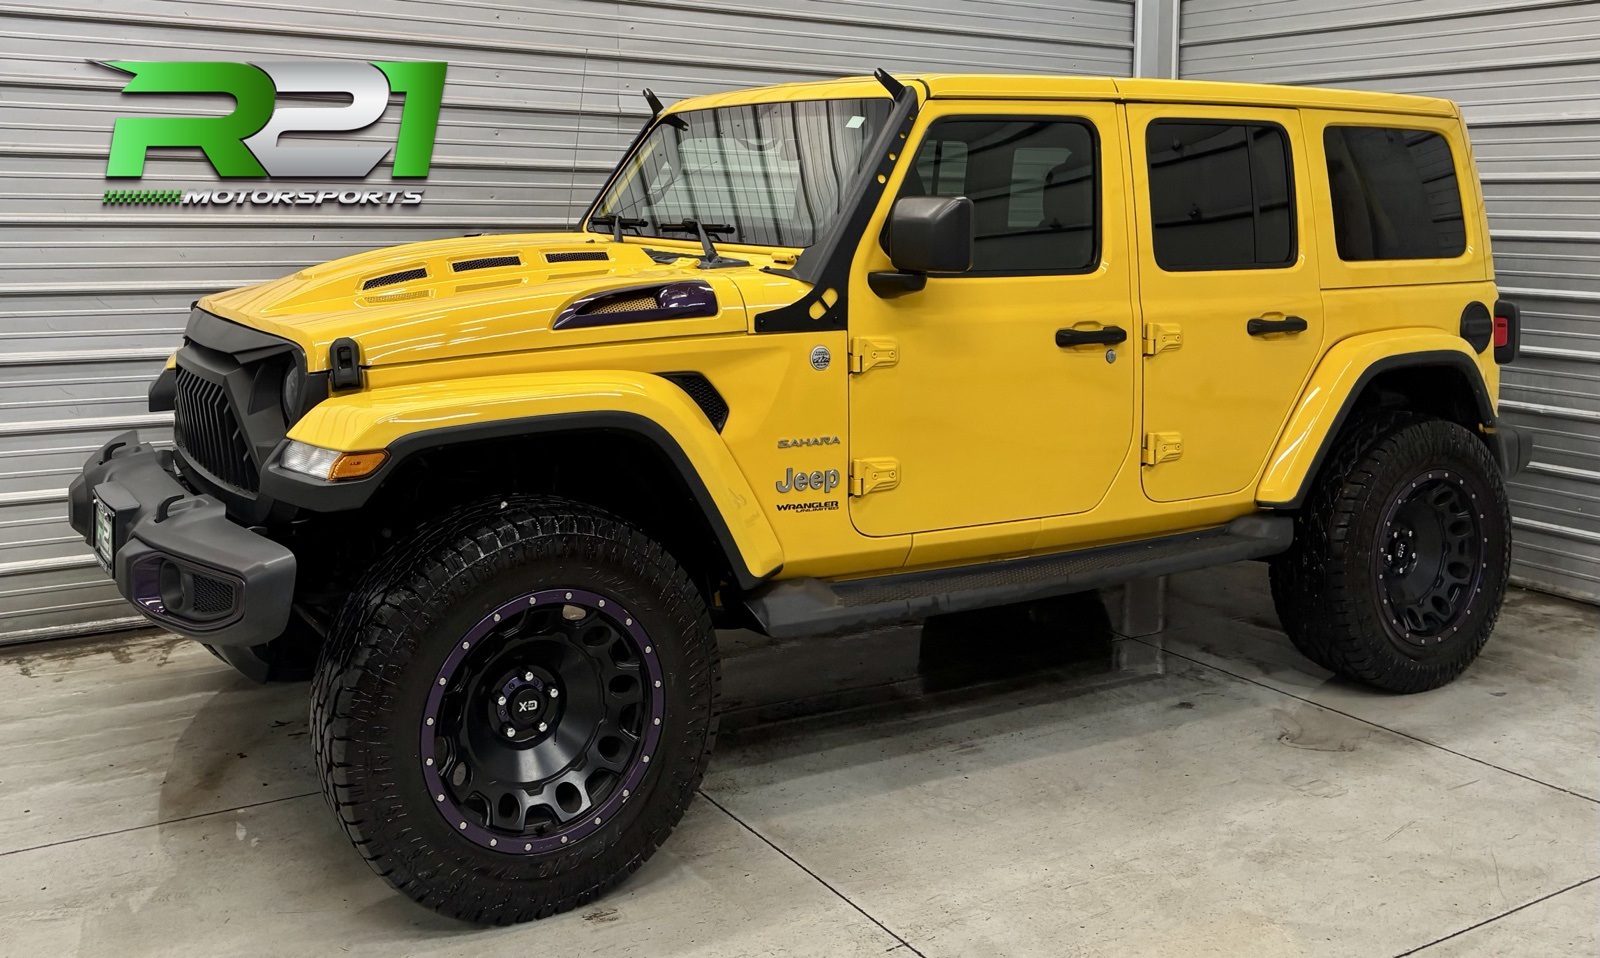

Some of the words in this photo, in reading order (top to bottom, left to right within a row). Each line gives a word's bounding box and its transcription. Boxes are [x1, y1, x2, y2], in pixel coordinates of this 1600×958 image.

[777, 436, 841, 448] SAHARA
[776, 467, 840, 493] Jeep
[776, 500, 839, 511] WRANGLER
